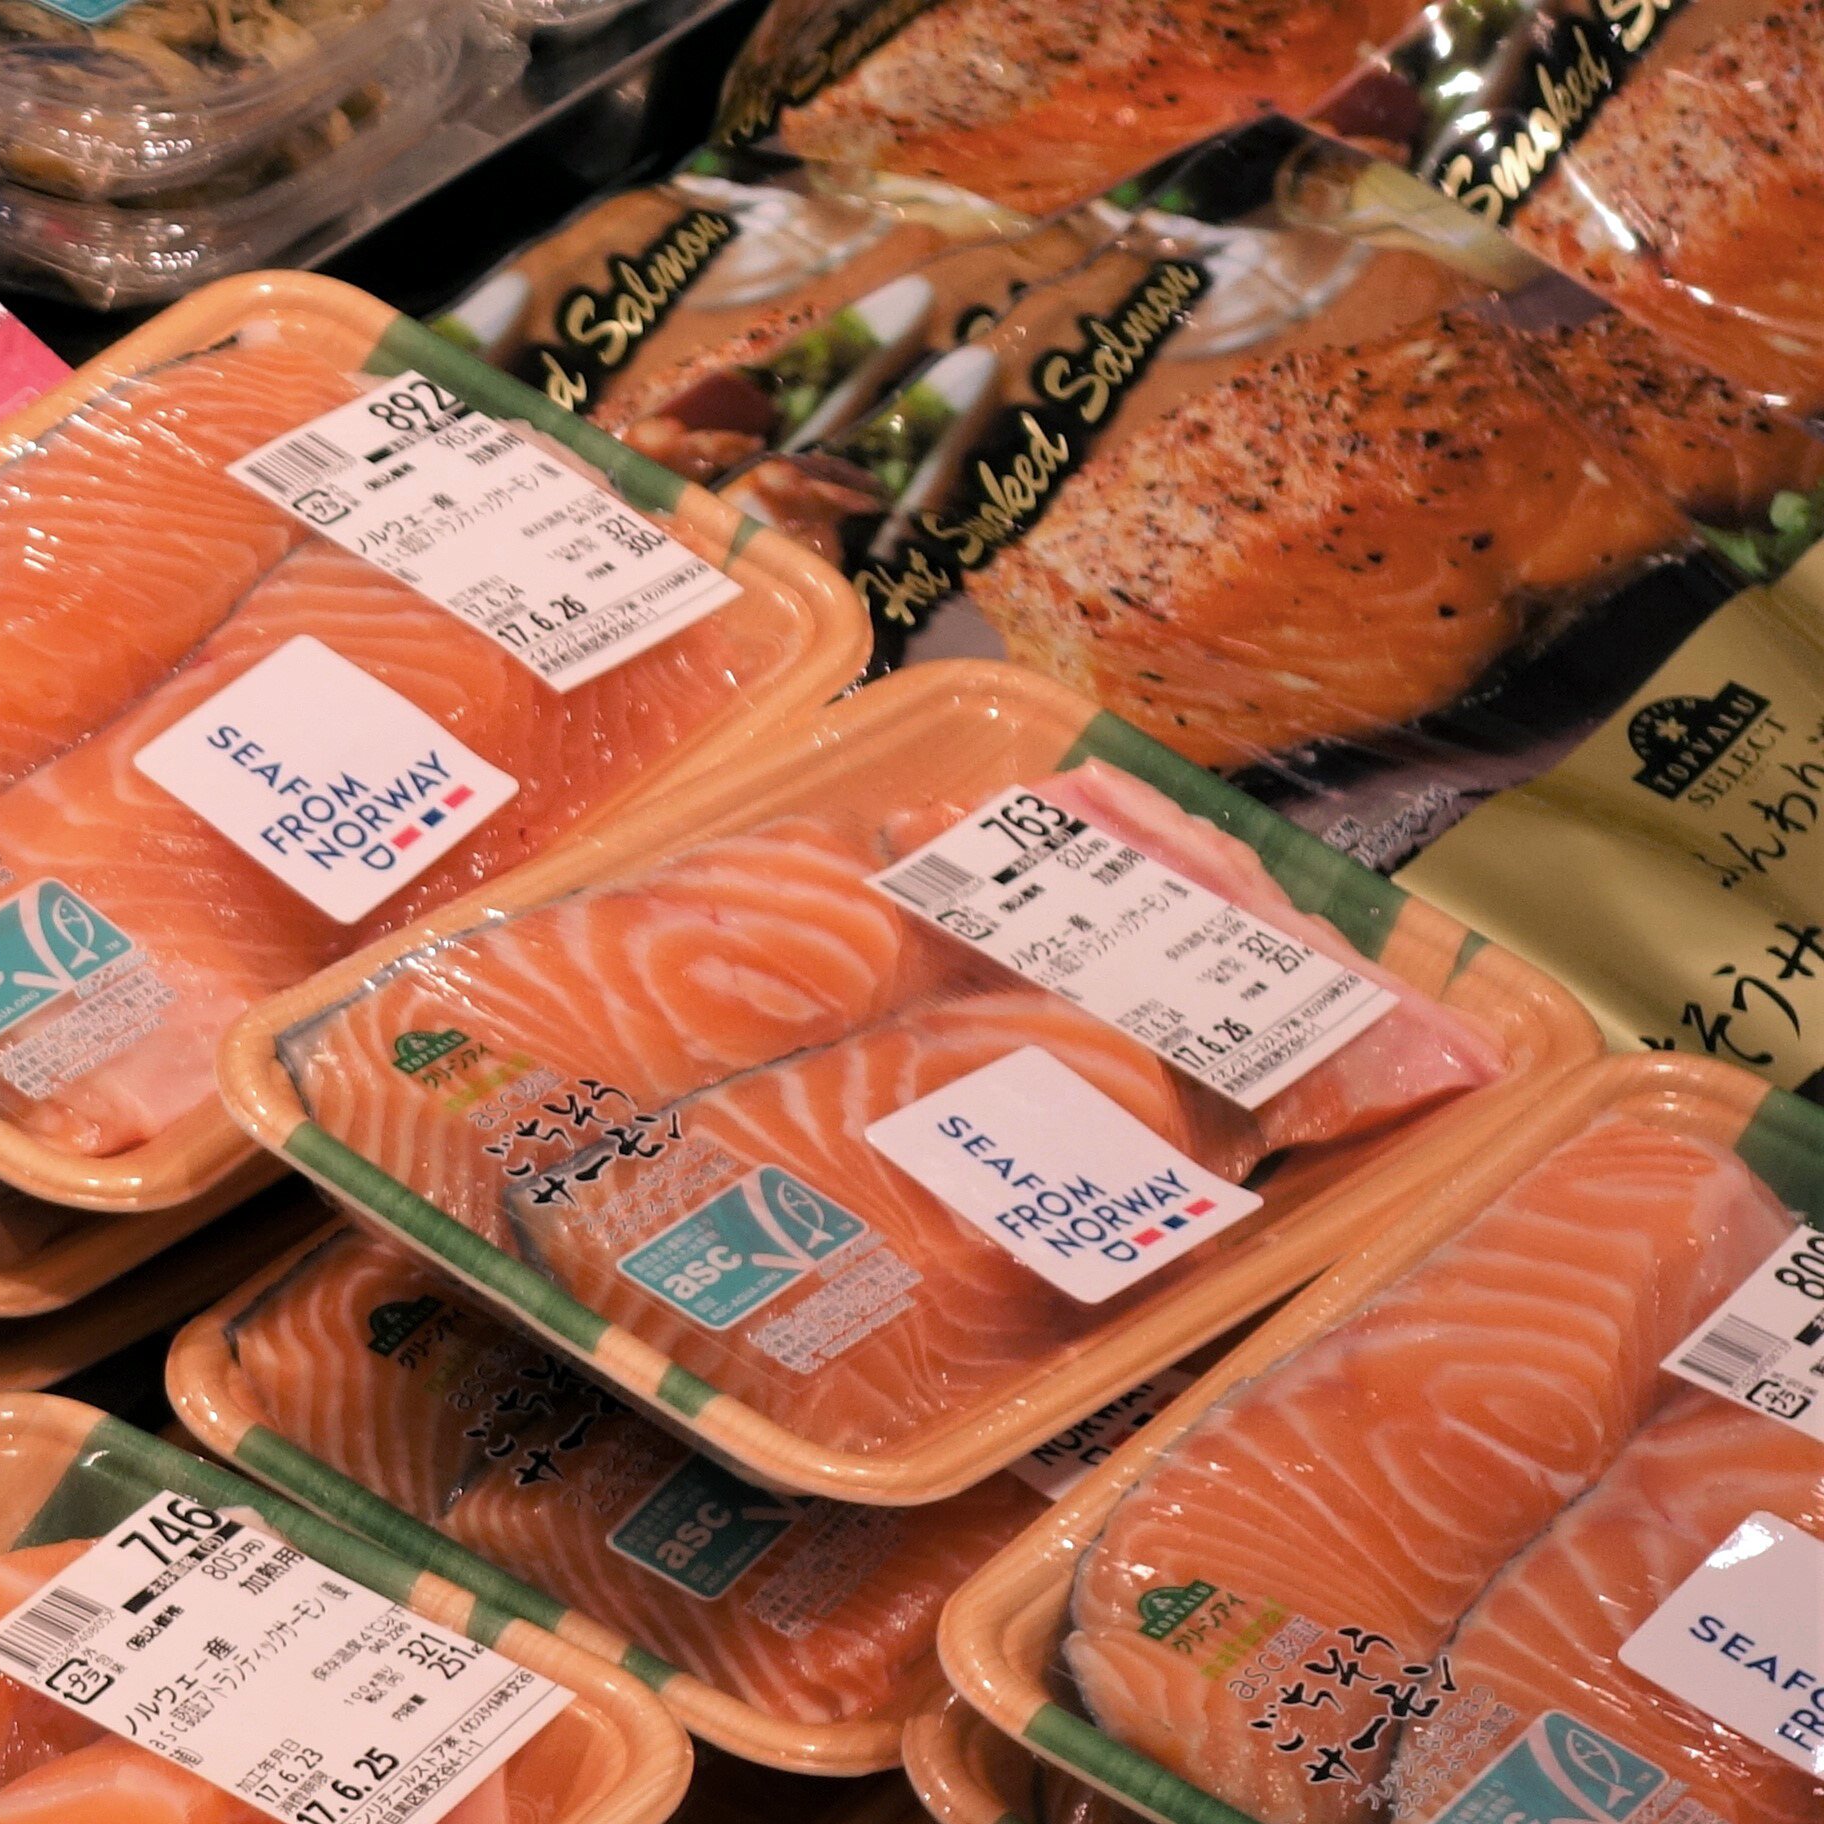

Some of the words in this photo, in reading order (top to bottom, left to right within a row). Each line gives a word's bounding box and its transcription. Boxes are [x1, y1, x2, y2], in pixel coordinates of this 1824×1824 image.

[1440, 27, 1611, 229] Smoked
[566, 208, 728, 366] Salmon
[369, 373, 460, 433] 892
[855, 552, 949, 627] Hot
[923, 412, 1067, 568] Smoked
[1045, 255, 1201, 423] Salmon
[1653, 693, 1757, 790] TOPVALU
[1687, 715, 1787, 809] SELECT
[259, 771, 369, 857] FROM
[307, 749, 456, 869] NORWAY
[980, 795, 1072, 851] 763
[992, 1176, 1100, 1240] FROM
[1046, 1169, 1192, 1258] NORWAY
[118, 1492, 232, 1573] 746
[126, 1637, 237, 1735] ノルウェー産
